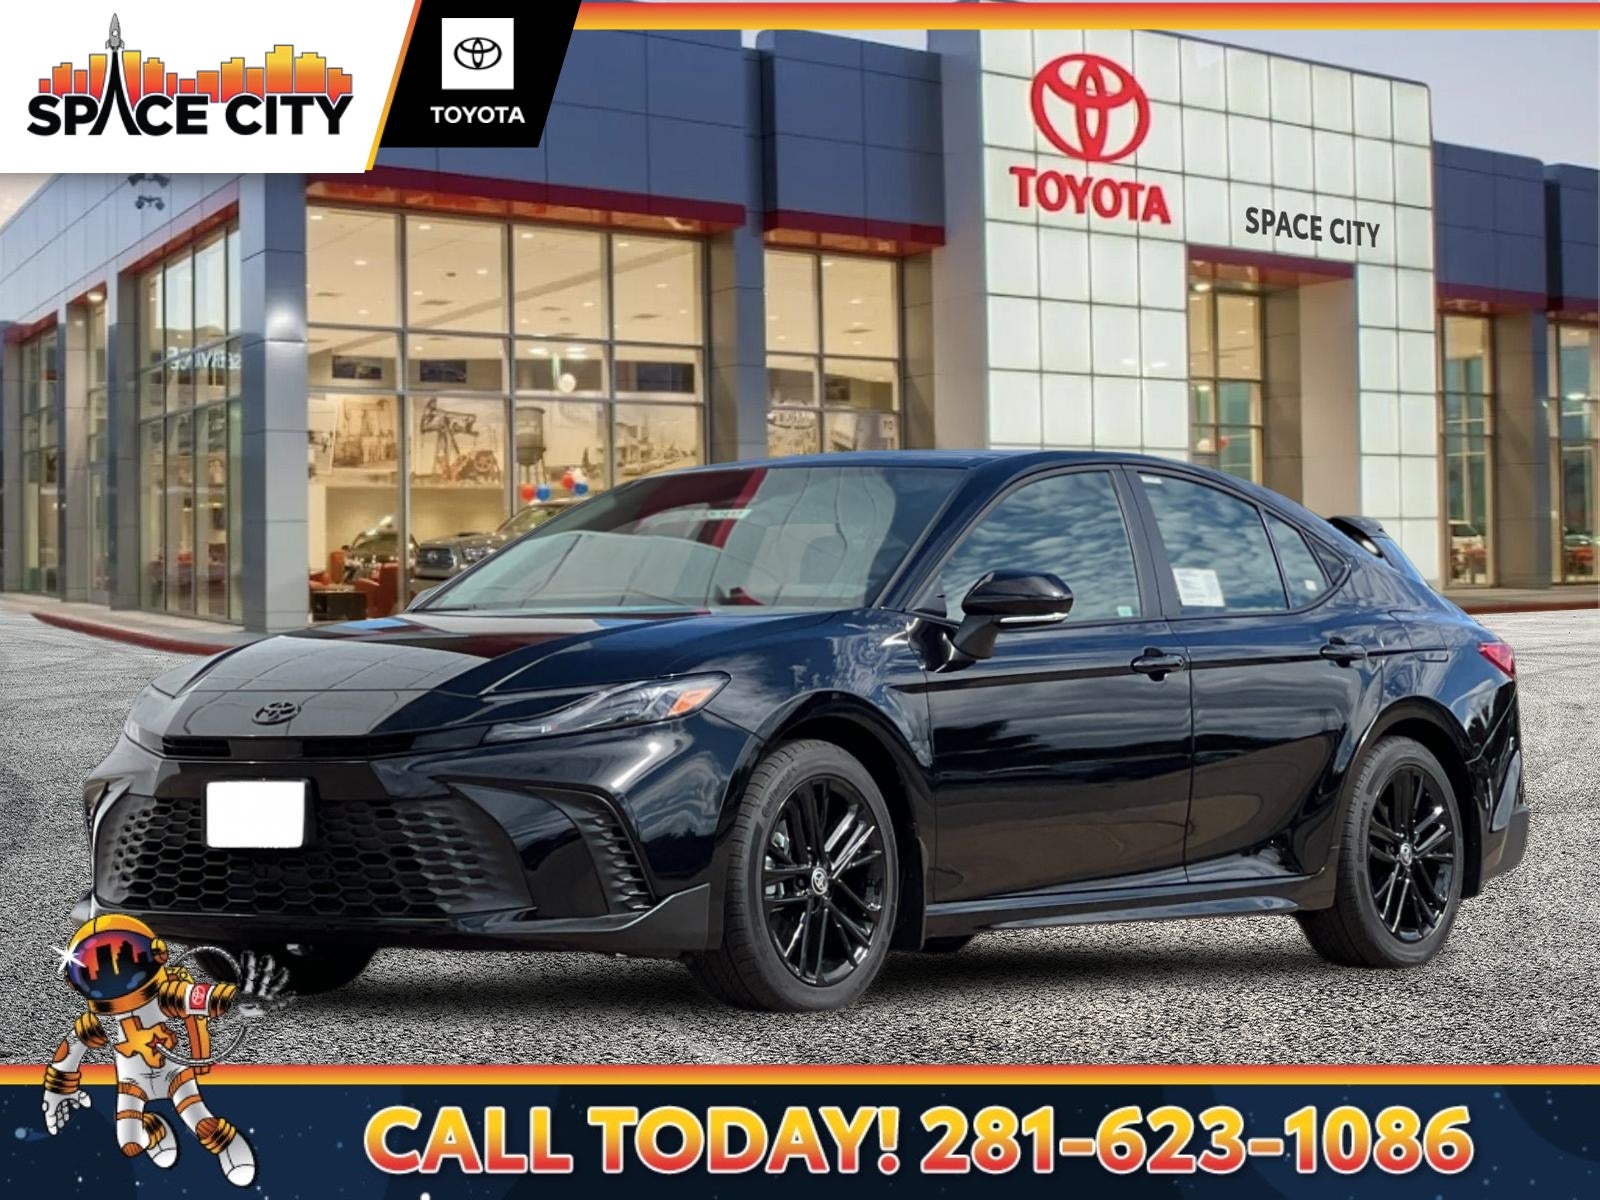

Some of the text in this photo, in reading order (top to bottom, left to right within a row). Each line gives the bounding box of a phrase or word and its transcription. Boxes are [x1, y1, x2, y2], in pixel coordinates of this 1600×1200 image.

[1009, 165, 1171, 224] TOYOTA
[1245, 207, 1380, 248] SPACE CITY
